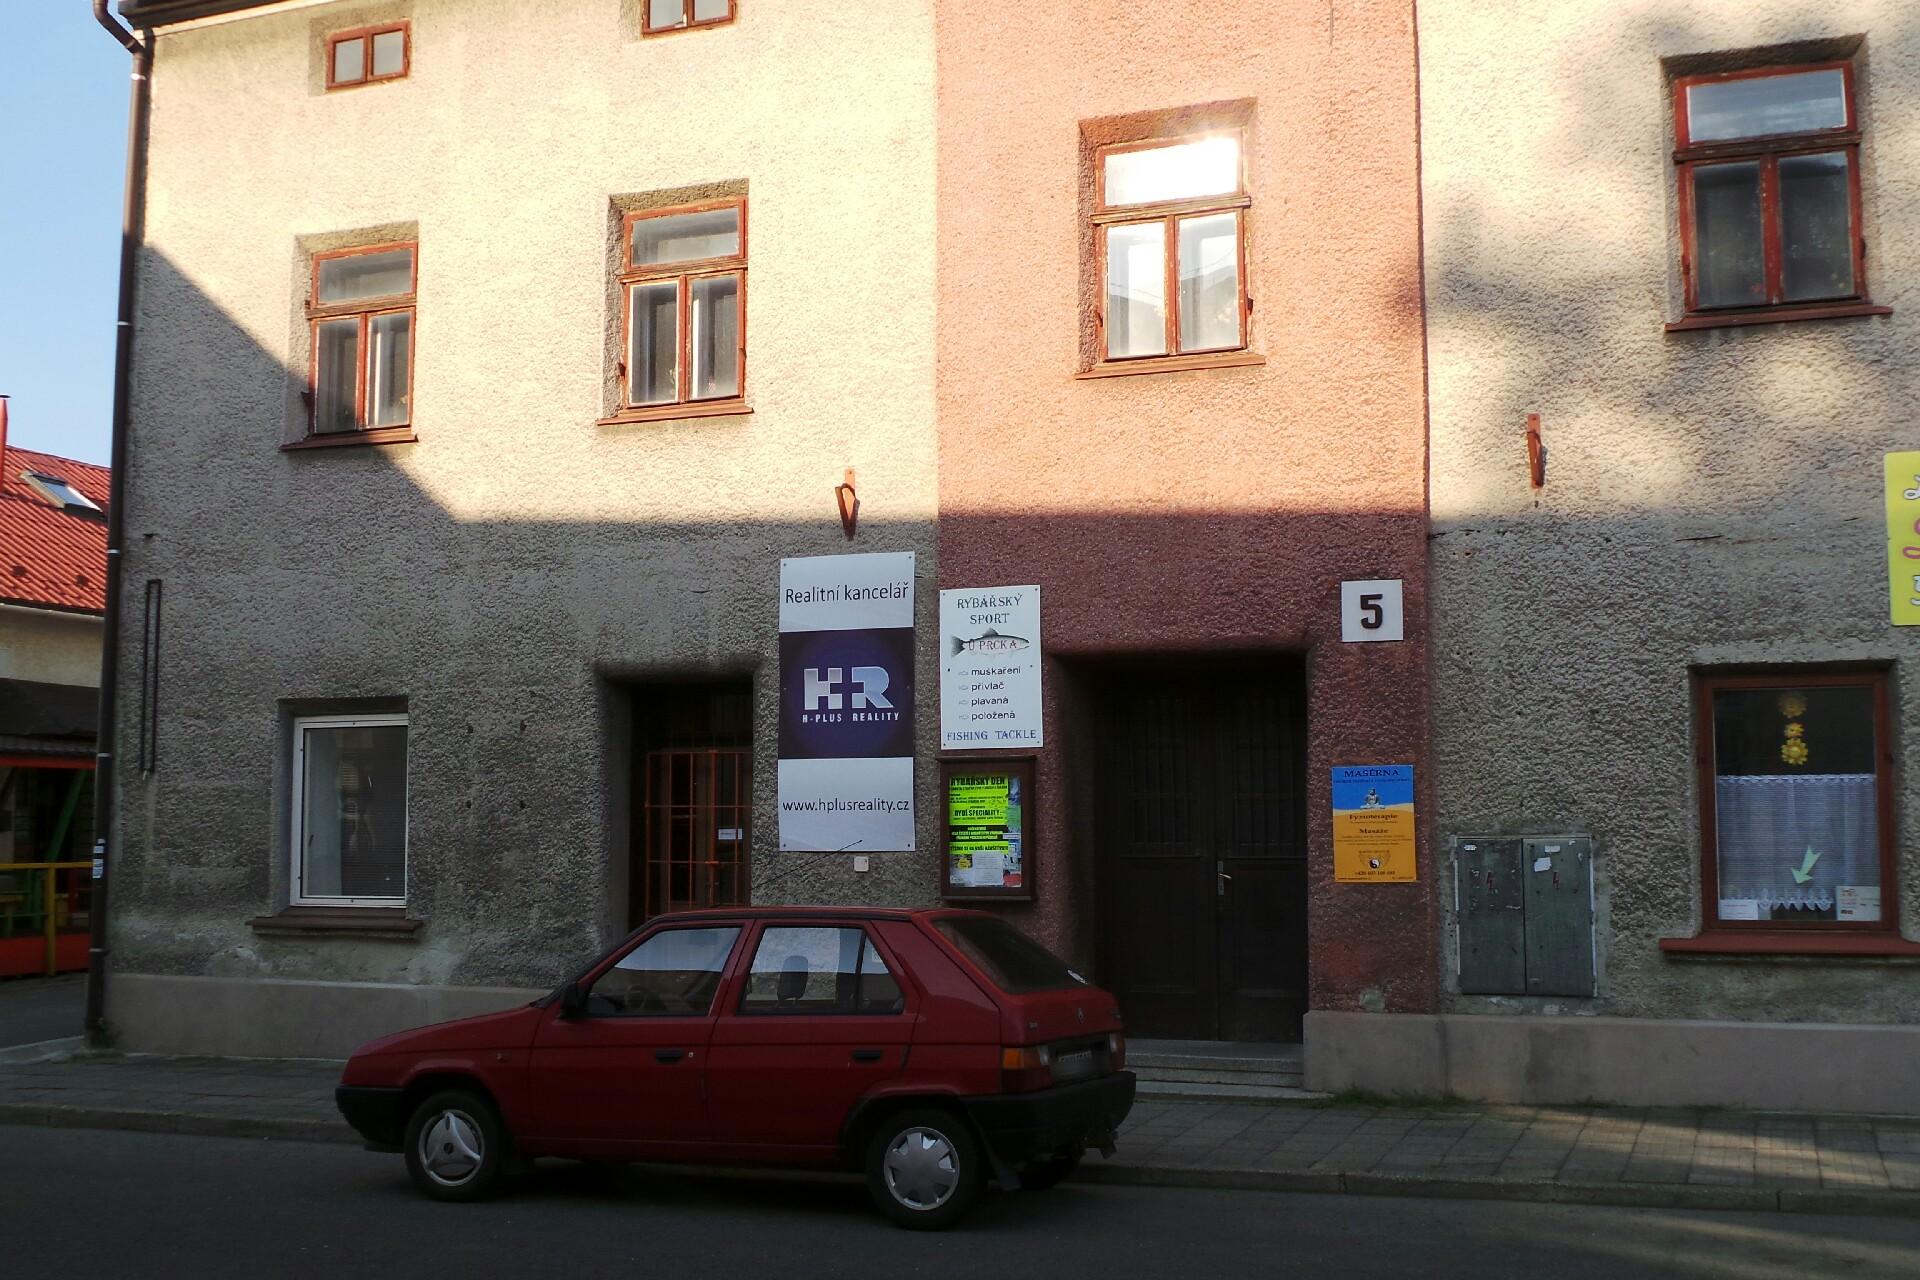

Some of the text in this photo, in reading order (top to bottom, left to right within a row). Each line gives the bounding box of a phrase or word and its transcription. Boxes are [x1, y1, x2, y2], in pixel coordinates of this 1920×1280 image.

[784, 581, 909, 604] Realitní kancelář
[956, 593, 1023, 609] RYBÁŘSKÝ
[1359, 593, 1383, 629] 5
[969, 612, 1011, 625] SPORT
[970, 665, 1021, 676] muškaření
[970, 681, 1005, 692] přivlač
[970, 695, 1009, 707] plavaná
[802, 711, 900, 724] H-PLUS REALITY
[970, 709, 1016, 722] položená
[947, 729, 1037, 741] FISHING TACKLE
[1343, 768, 1399, 778] MASÉRNA
[782, 797, 910, 814] www.hplusreality.cz
